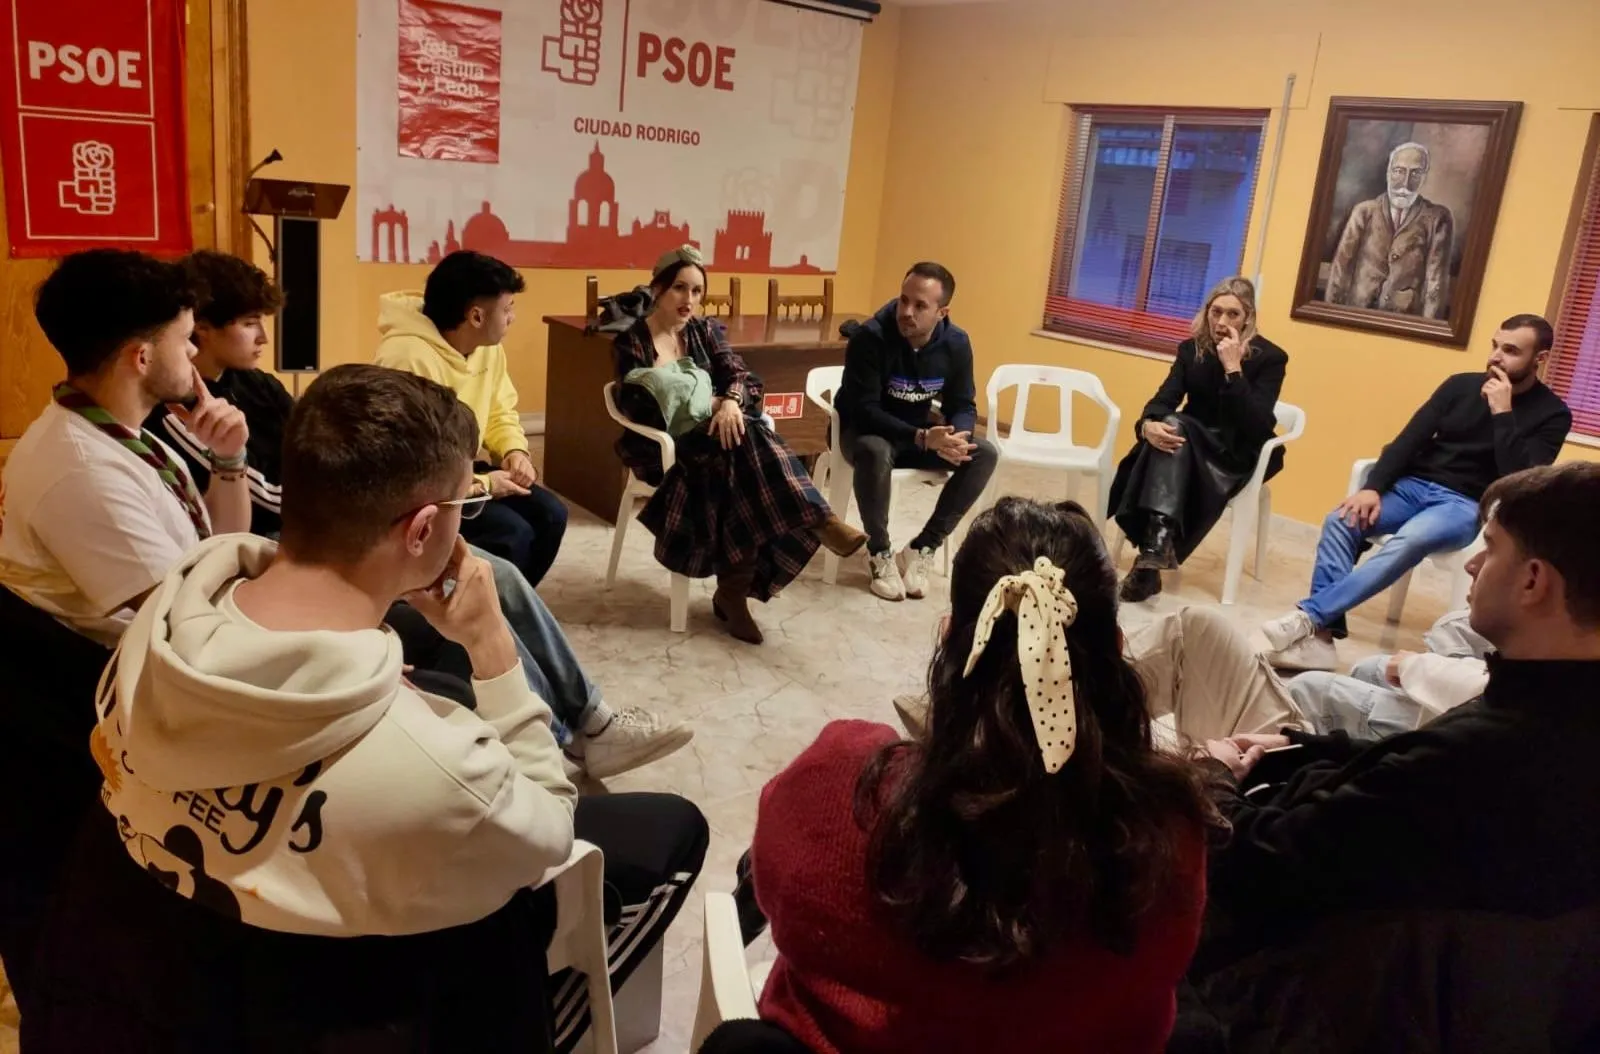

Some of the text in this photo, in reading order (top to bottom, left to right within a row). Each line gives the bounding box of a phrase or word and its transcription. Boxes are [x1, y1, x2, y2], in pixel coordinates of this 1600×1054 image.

[28, 40, 142, 89] PSOE
[416, 56, 485, 80] Castilla
[637, 31, 736, 91] PSOE
[416, 77, 428, 95] y
[574, 117, 700, 146] CIUDAD RODRIGO
